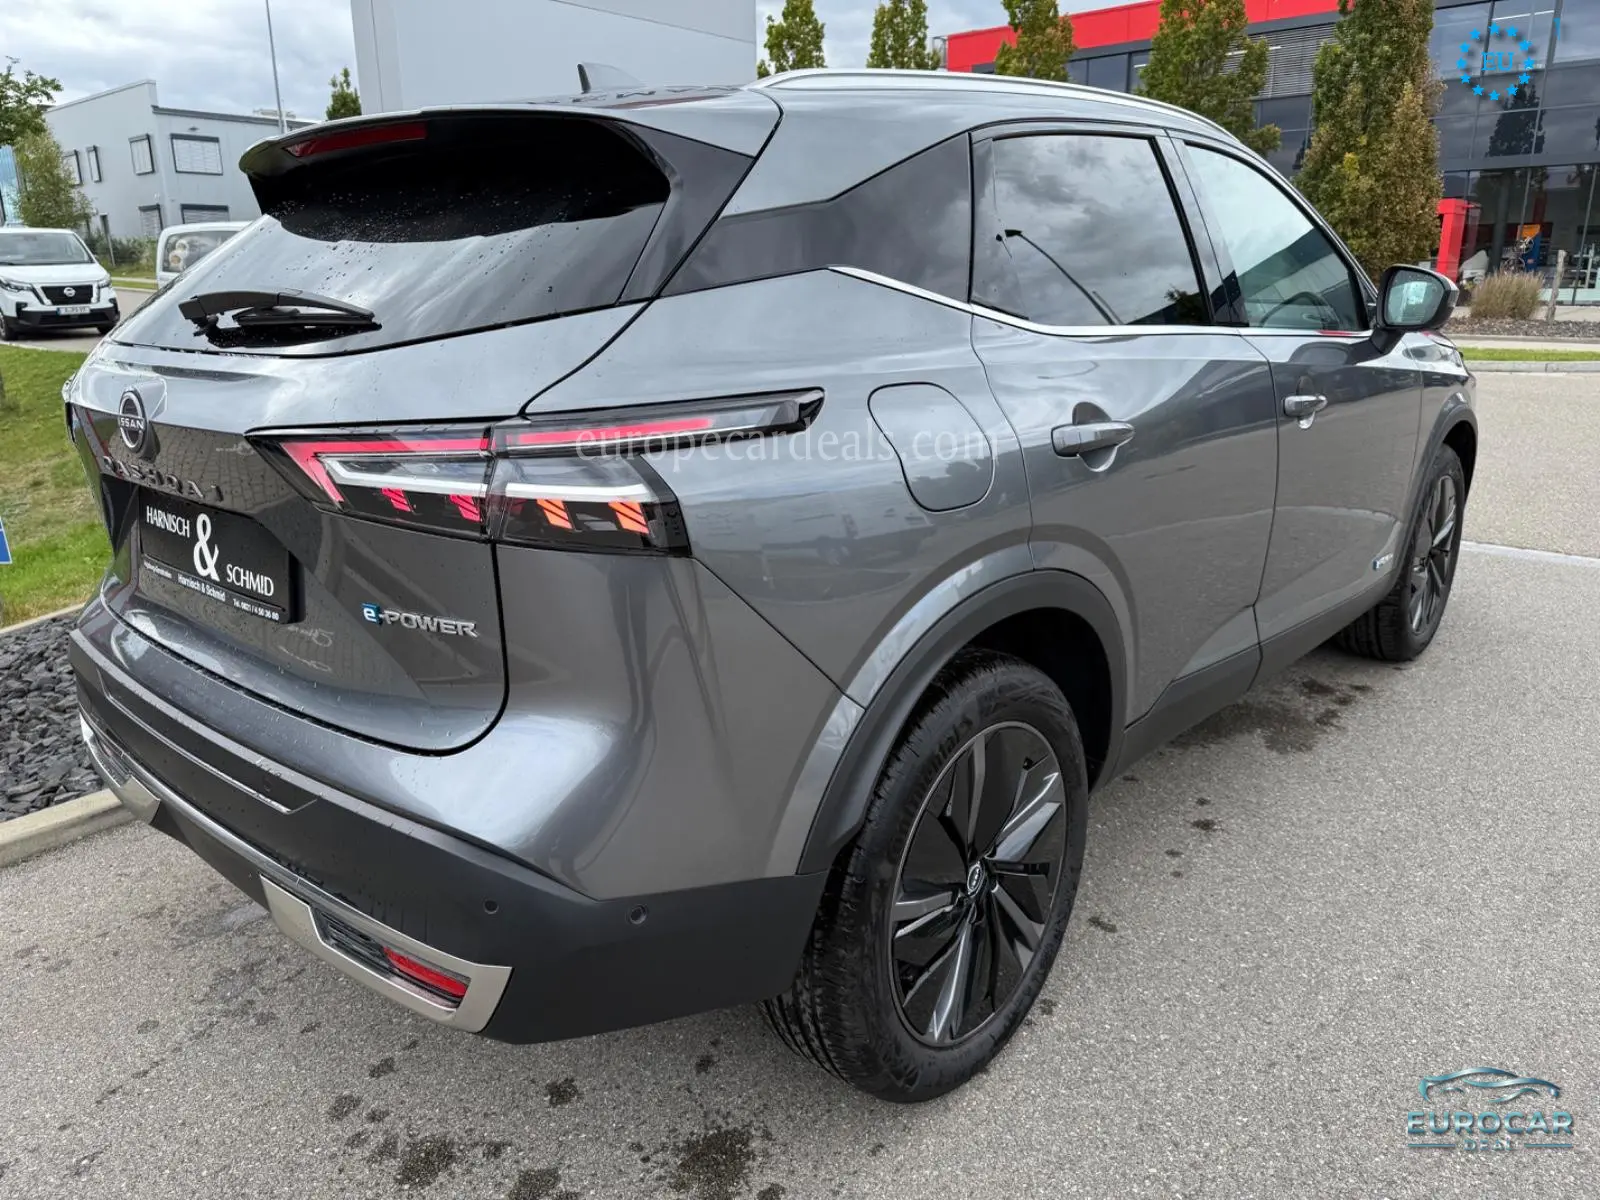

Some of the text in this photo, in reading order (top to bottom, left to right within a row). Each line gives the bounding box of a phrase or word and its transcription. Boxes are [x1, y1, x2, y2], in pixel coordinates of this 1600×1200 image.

[146, 505, 190, 538] HARNISCH
[193, 512, 220, 582] &
[226, 563, 274, 597] SCHMID
[205, 584, 226, 602] Schmid
[361, 602, 478, 638] e-POWER
